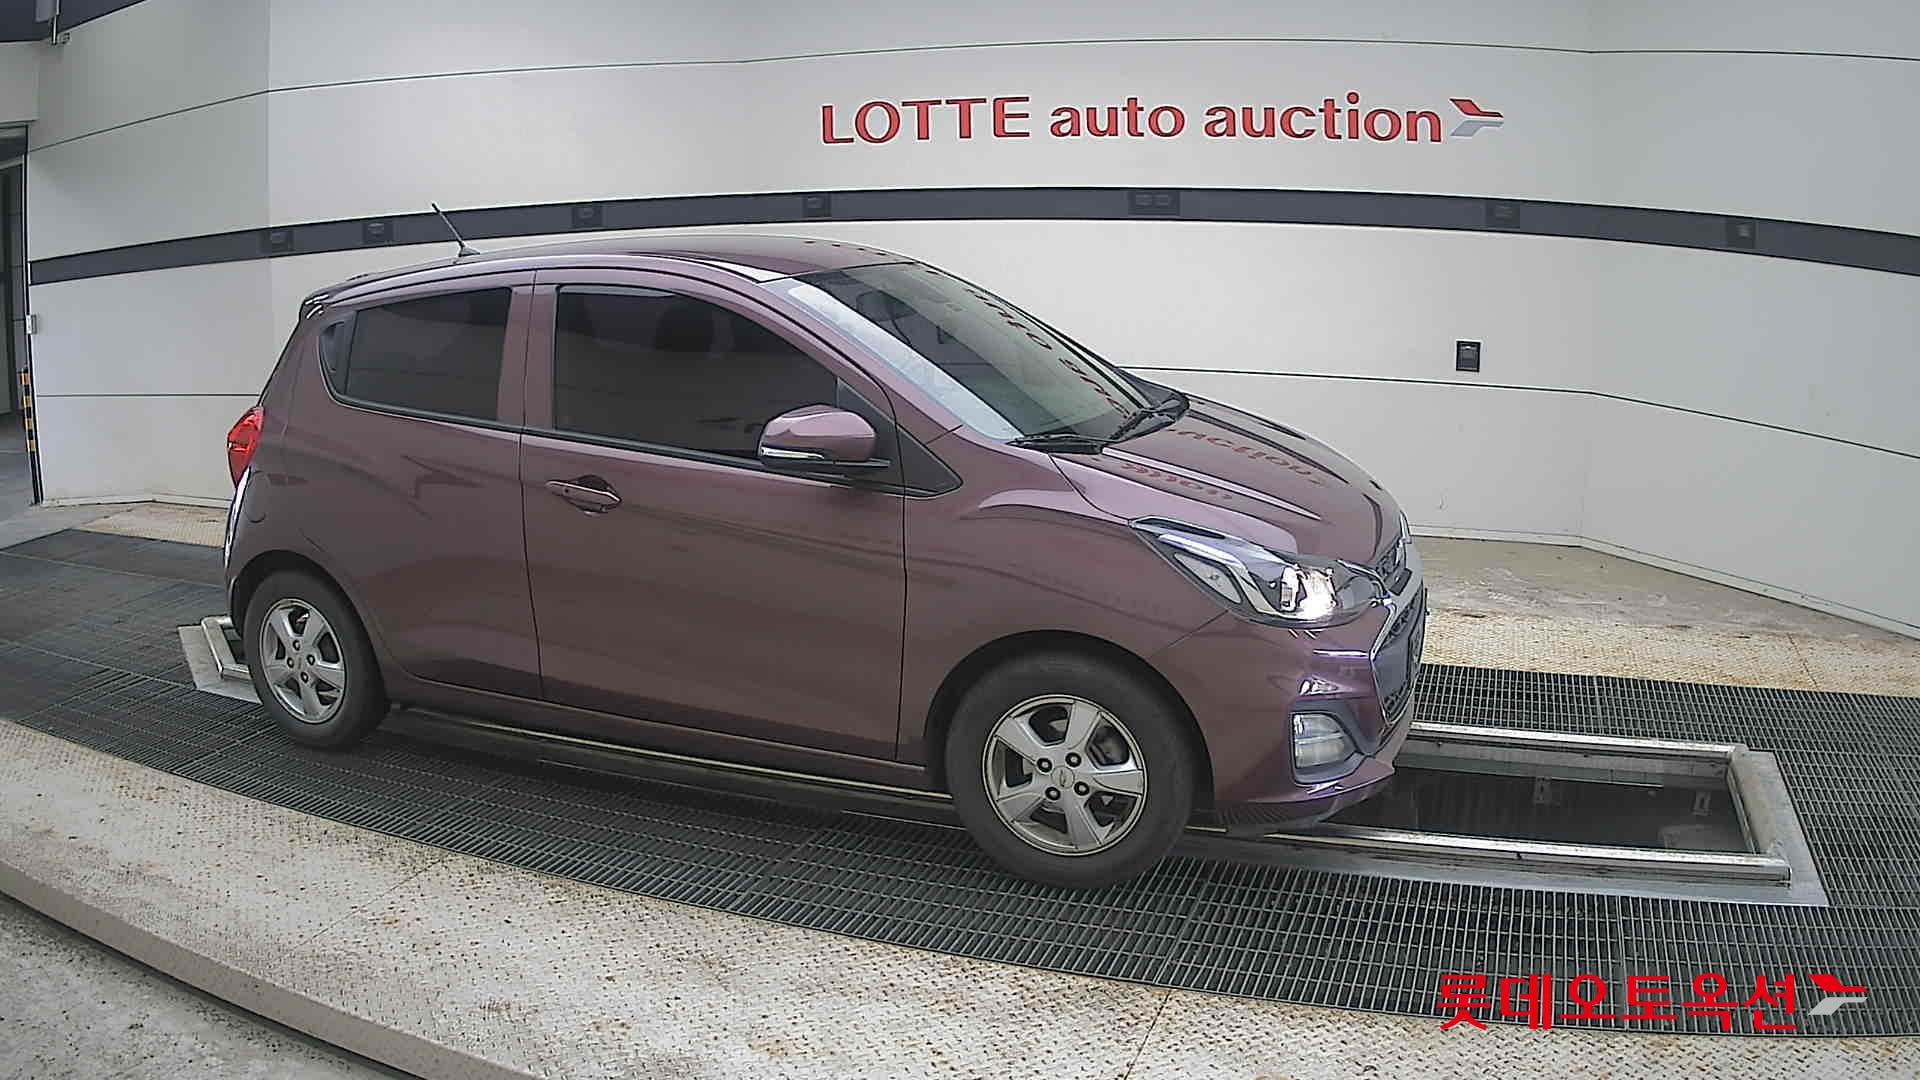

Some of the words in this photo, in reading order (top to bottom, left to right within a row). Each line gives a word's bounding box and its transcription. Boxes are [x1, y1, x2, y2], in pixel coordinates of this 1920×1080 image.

[821, 96, 1031, 145] LOTTE
[1049, 96, 1186, 138] auto
[1203, 92, 1443, 144] auction
